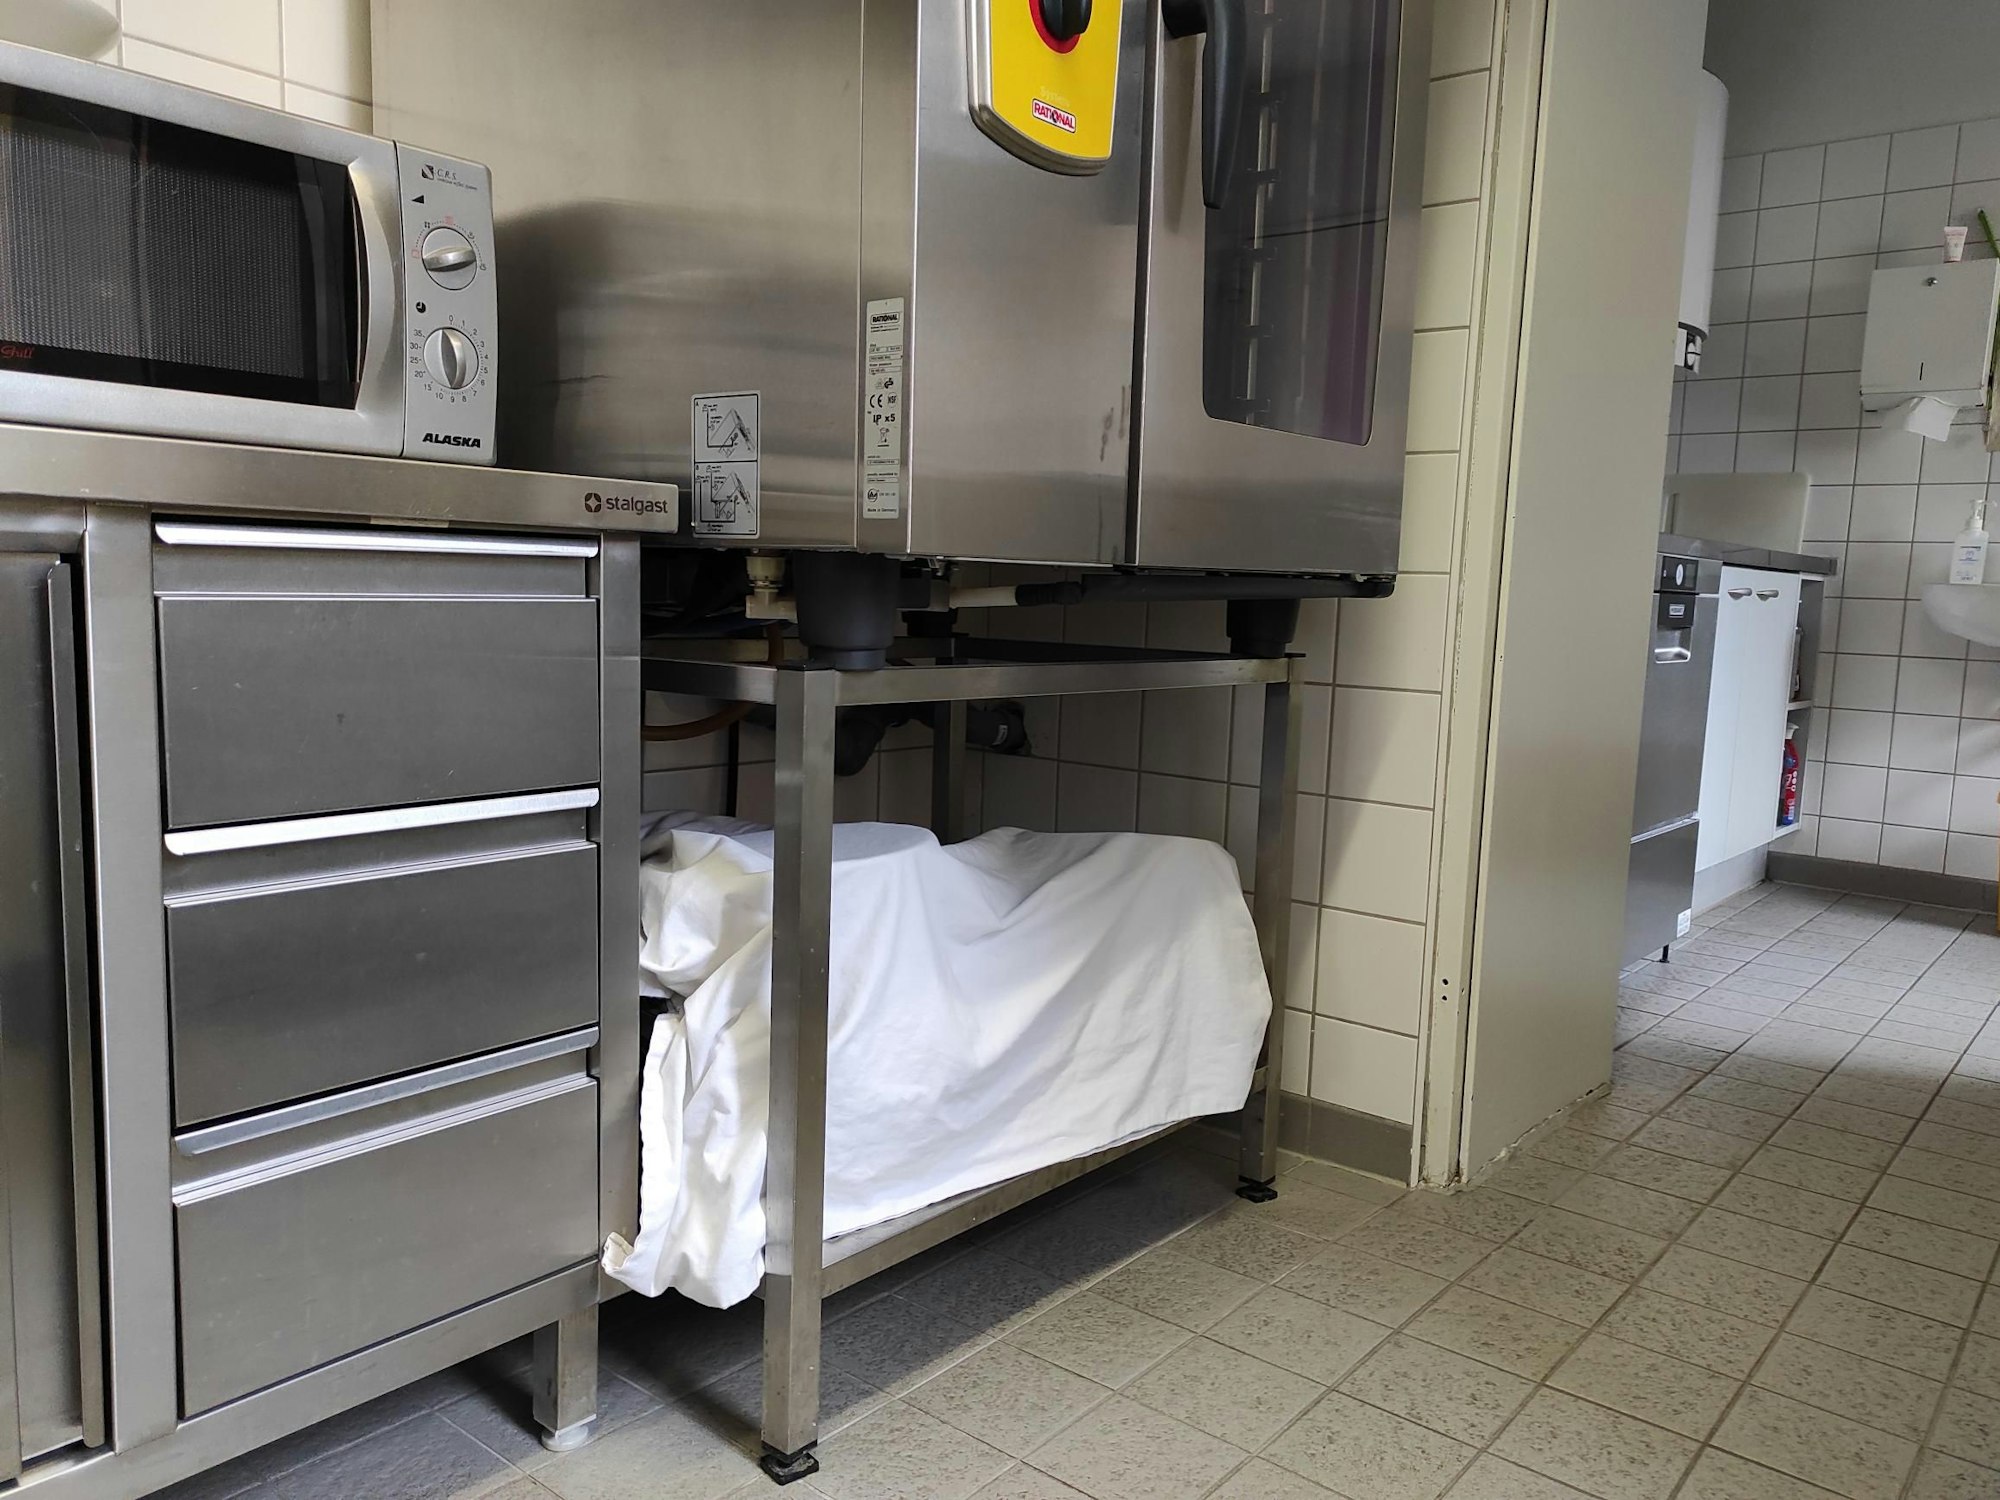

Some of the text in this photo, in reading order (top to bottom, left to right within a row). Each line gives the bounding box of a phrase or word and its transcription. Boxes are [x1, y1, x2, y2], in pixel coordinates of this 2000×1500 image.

[1034, 102, 1075, 129] RATIONAL
[448, 314, 454, 322] 0
[872, 313, 898, 323] RATIONAL
[413, 329, 423, 337] 35
[472, 328, 478, 336] 2
[409, 342, 419, 350] 30
[409, 356, 419, 364] 25
[414, 370, 424, 378] 20
[435, 392, 444, 400] 10
[462, 395, 467, 403] 8
[422, 433, 481, 449] ALASKA
[605, 496, 668, 516] stalgast
